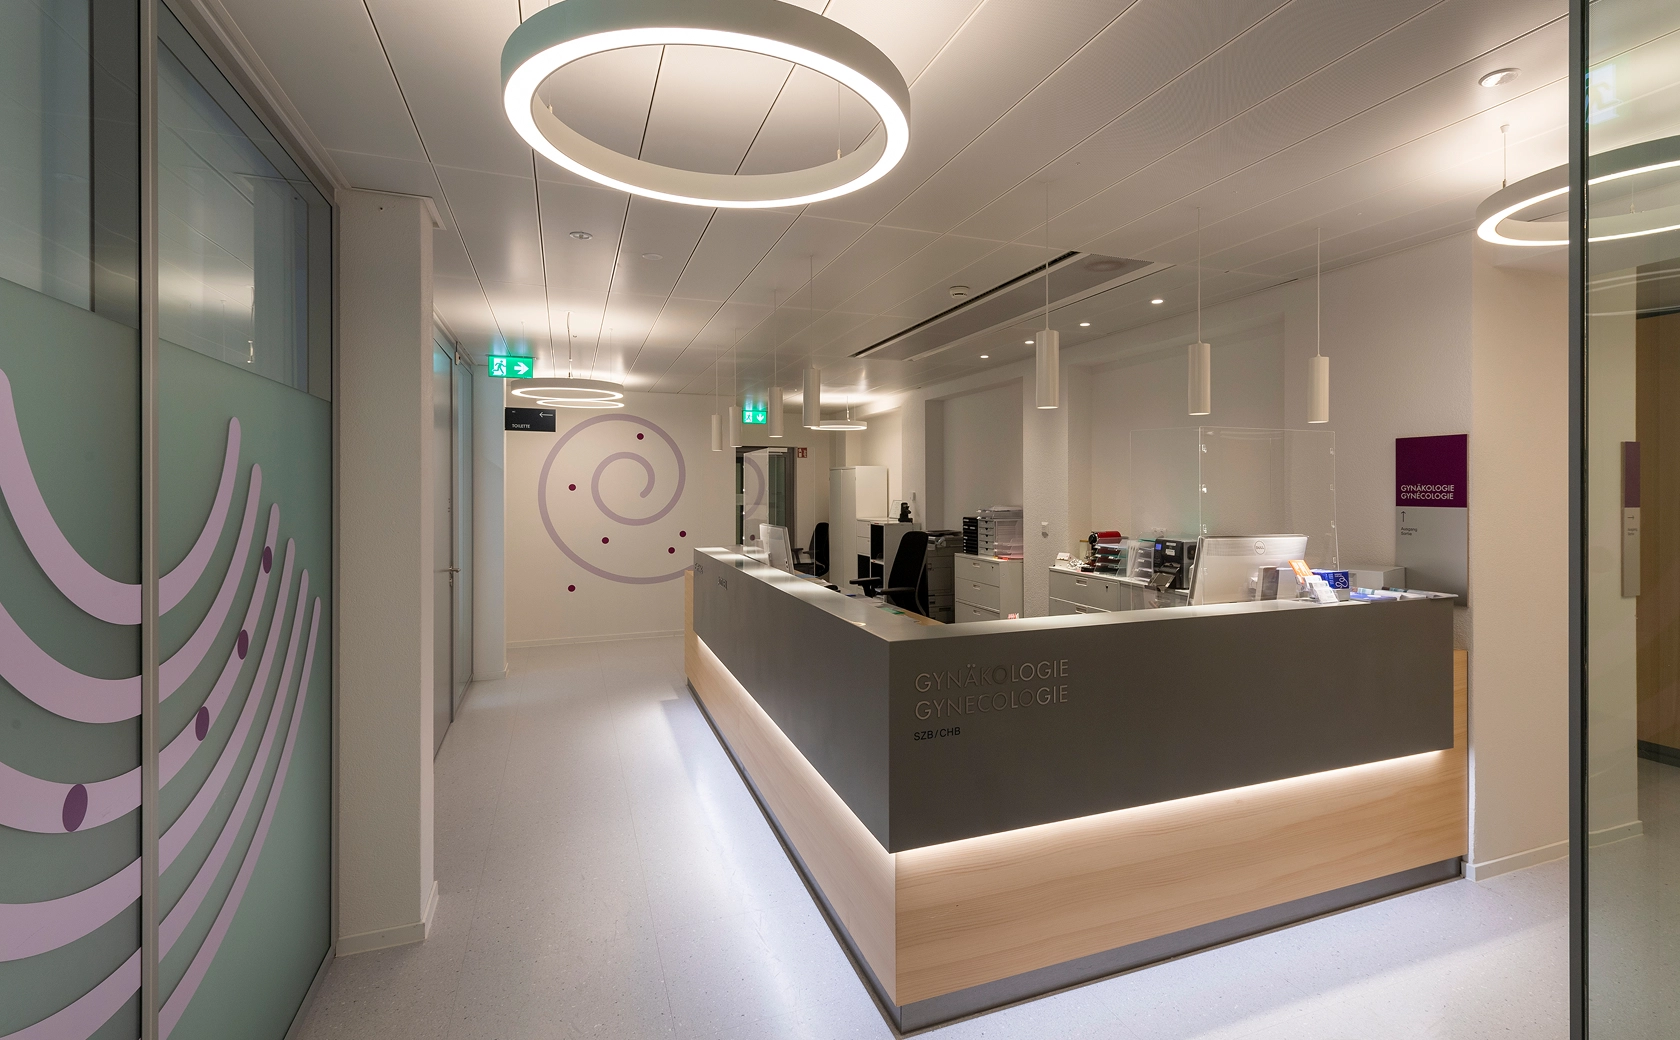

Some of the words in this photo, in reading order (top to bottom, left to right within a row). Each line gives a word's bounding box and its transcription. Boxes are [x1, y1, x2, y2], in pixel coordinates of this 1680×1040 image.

[1400, 484, 1455, 492] GYNÄKOLOGIE
[1400, 491, 1454, 500] GYNÉCOLOGIE
[915, 659, 1069, 693] GYNÄKOLOGIE
[913, 726, 962, 742] SZB/CHB
